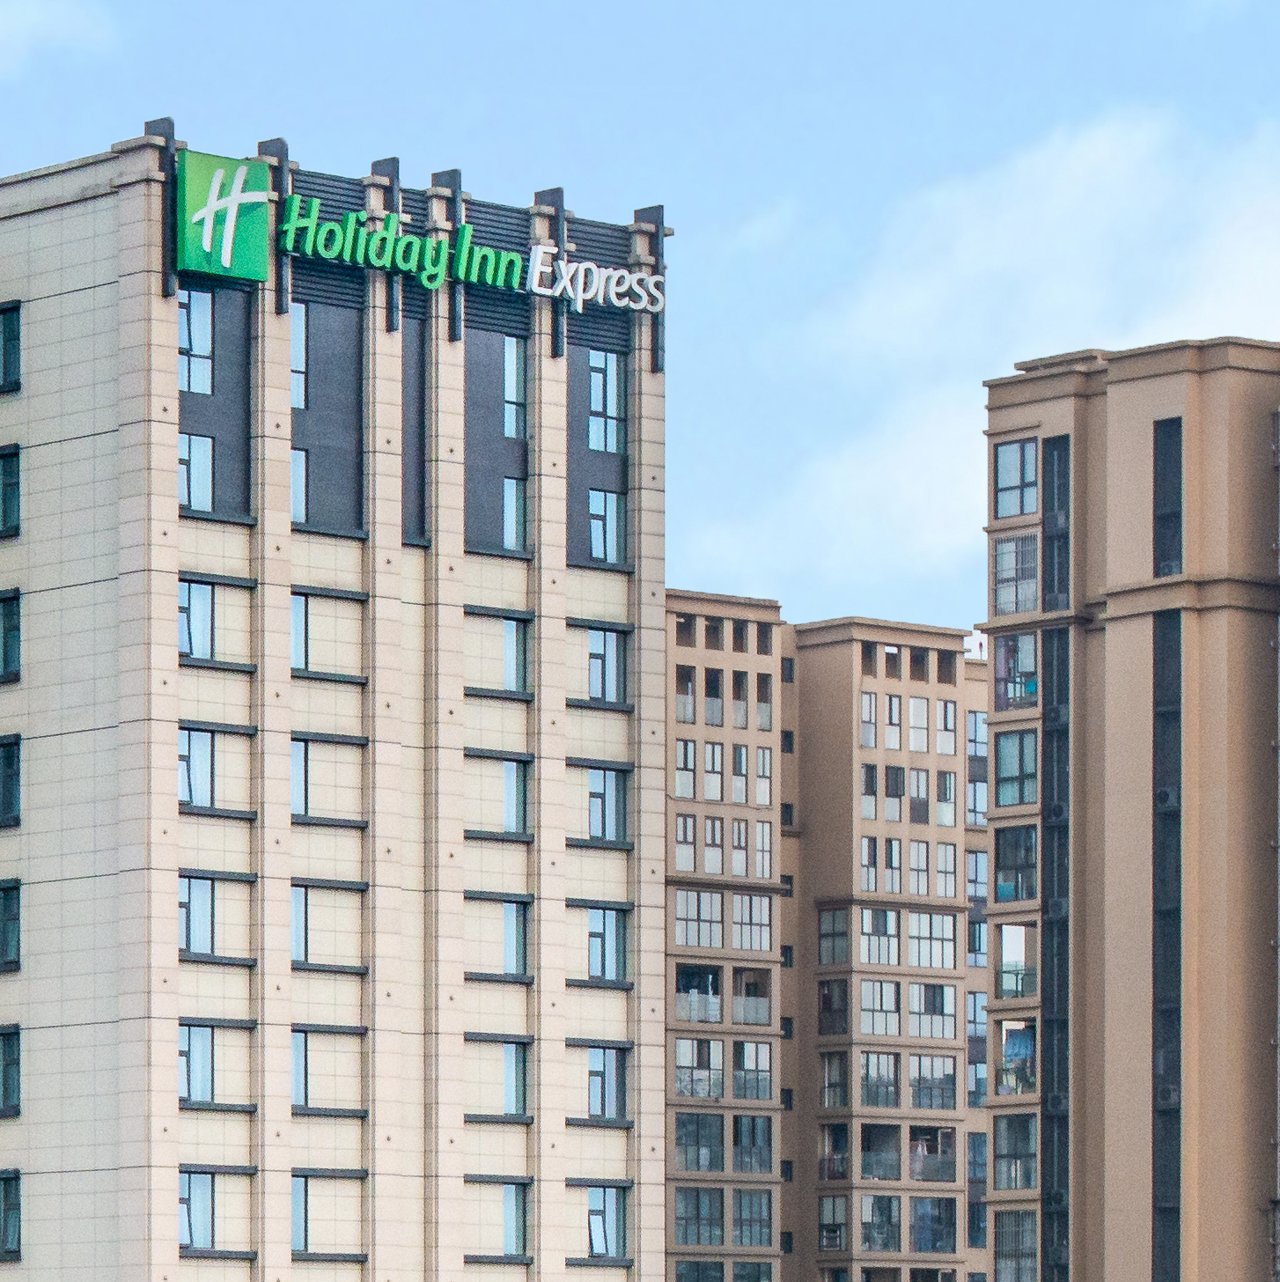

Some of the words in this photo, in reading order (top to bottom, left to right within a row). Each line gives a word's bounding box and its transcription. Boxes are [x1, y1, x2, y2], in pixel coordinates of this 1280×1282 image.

[279, 194, 448, 290] Holiday
[455, 223, 523, 290] Inn
[529, 244, 665, 313] Express
